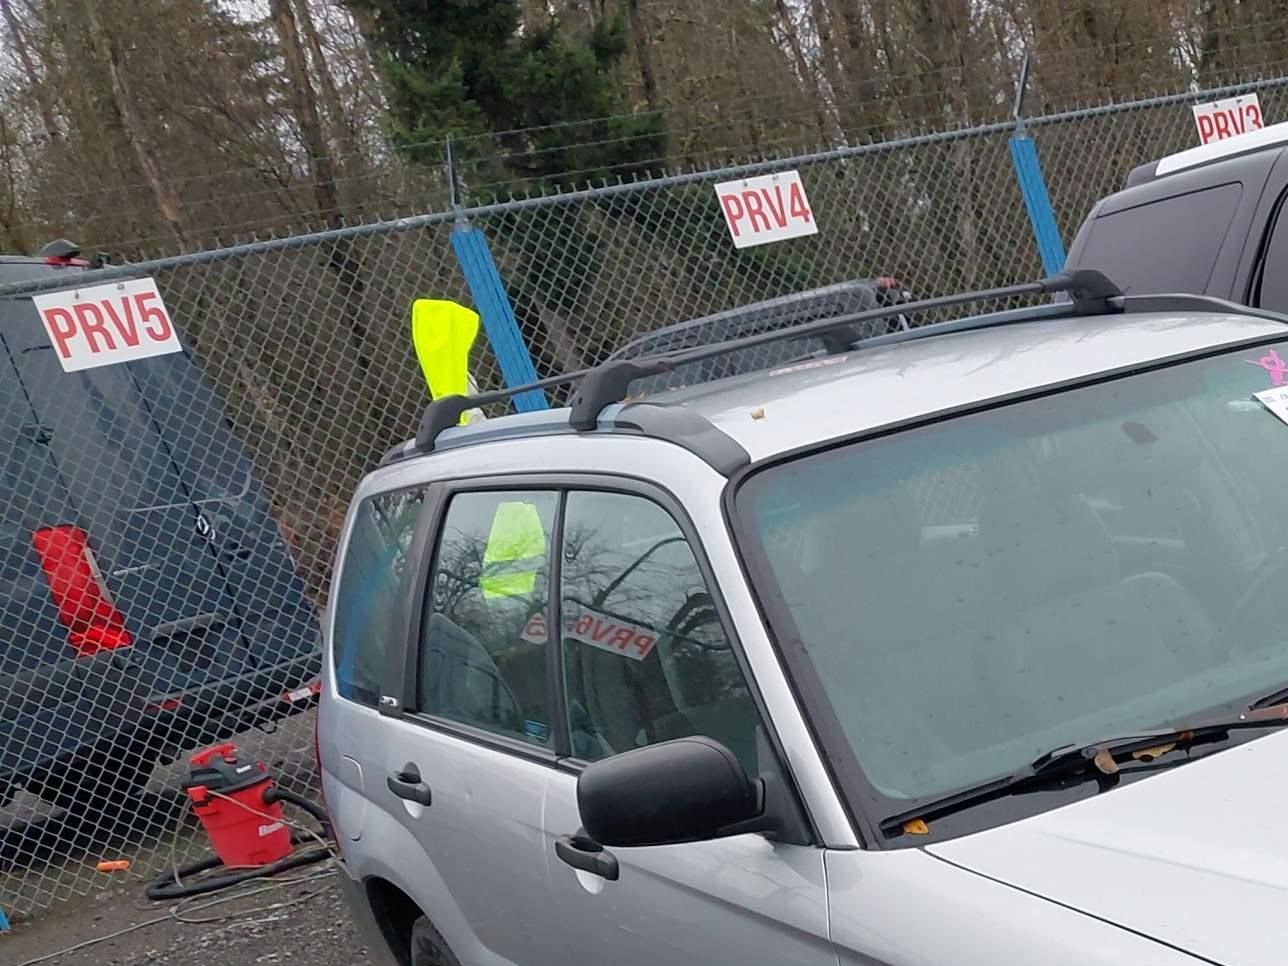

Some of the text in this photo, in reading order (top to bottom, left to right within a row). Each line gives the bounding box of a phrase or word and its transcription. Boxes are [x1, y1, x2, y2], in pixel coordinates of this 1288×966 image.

[1198, 104, 1262, 145] PRV3
[720, 182, 810, 237] PRV4
[42, 291, 172, 359] PRV5
